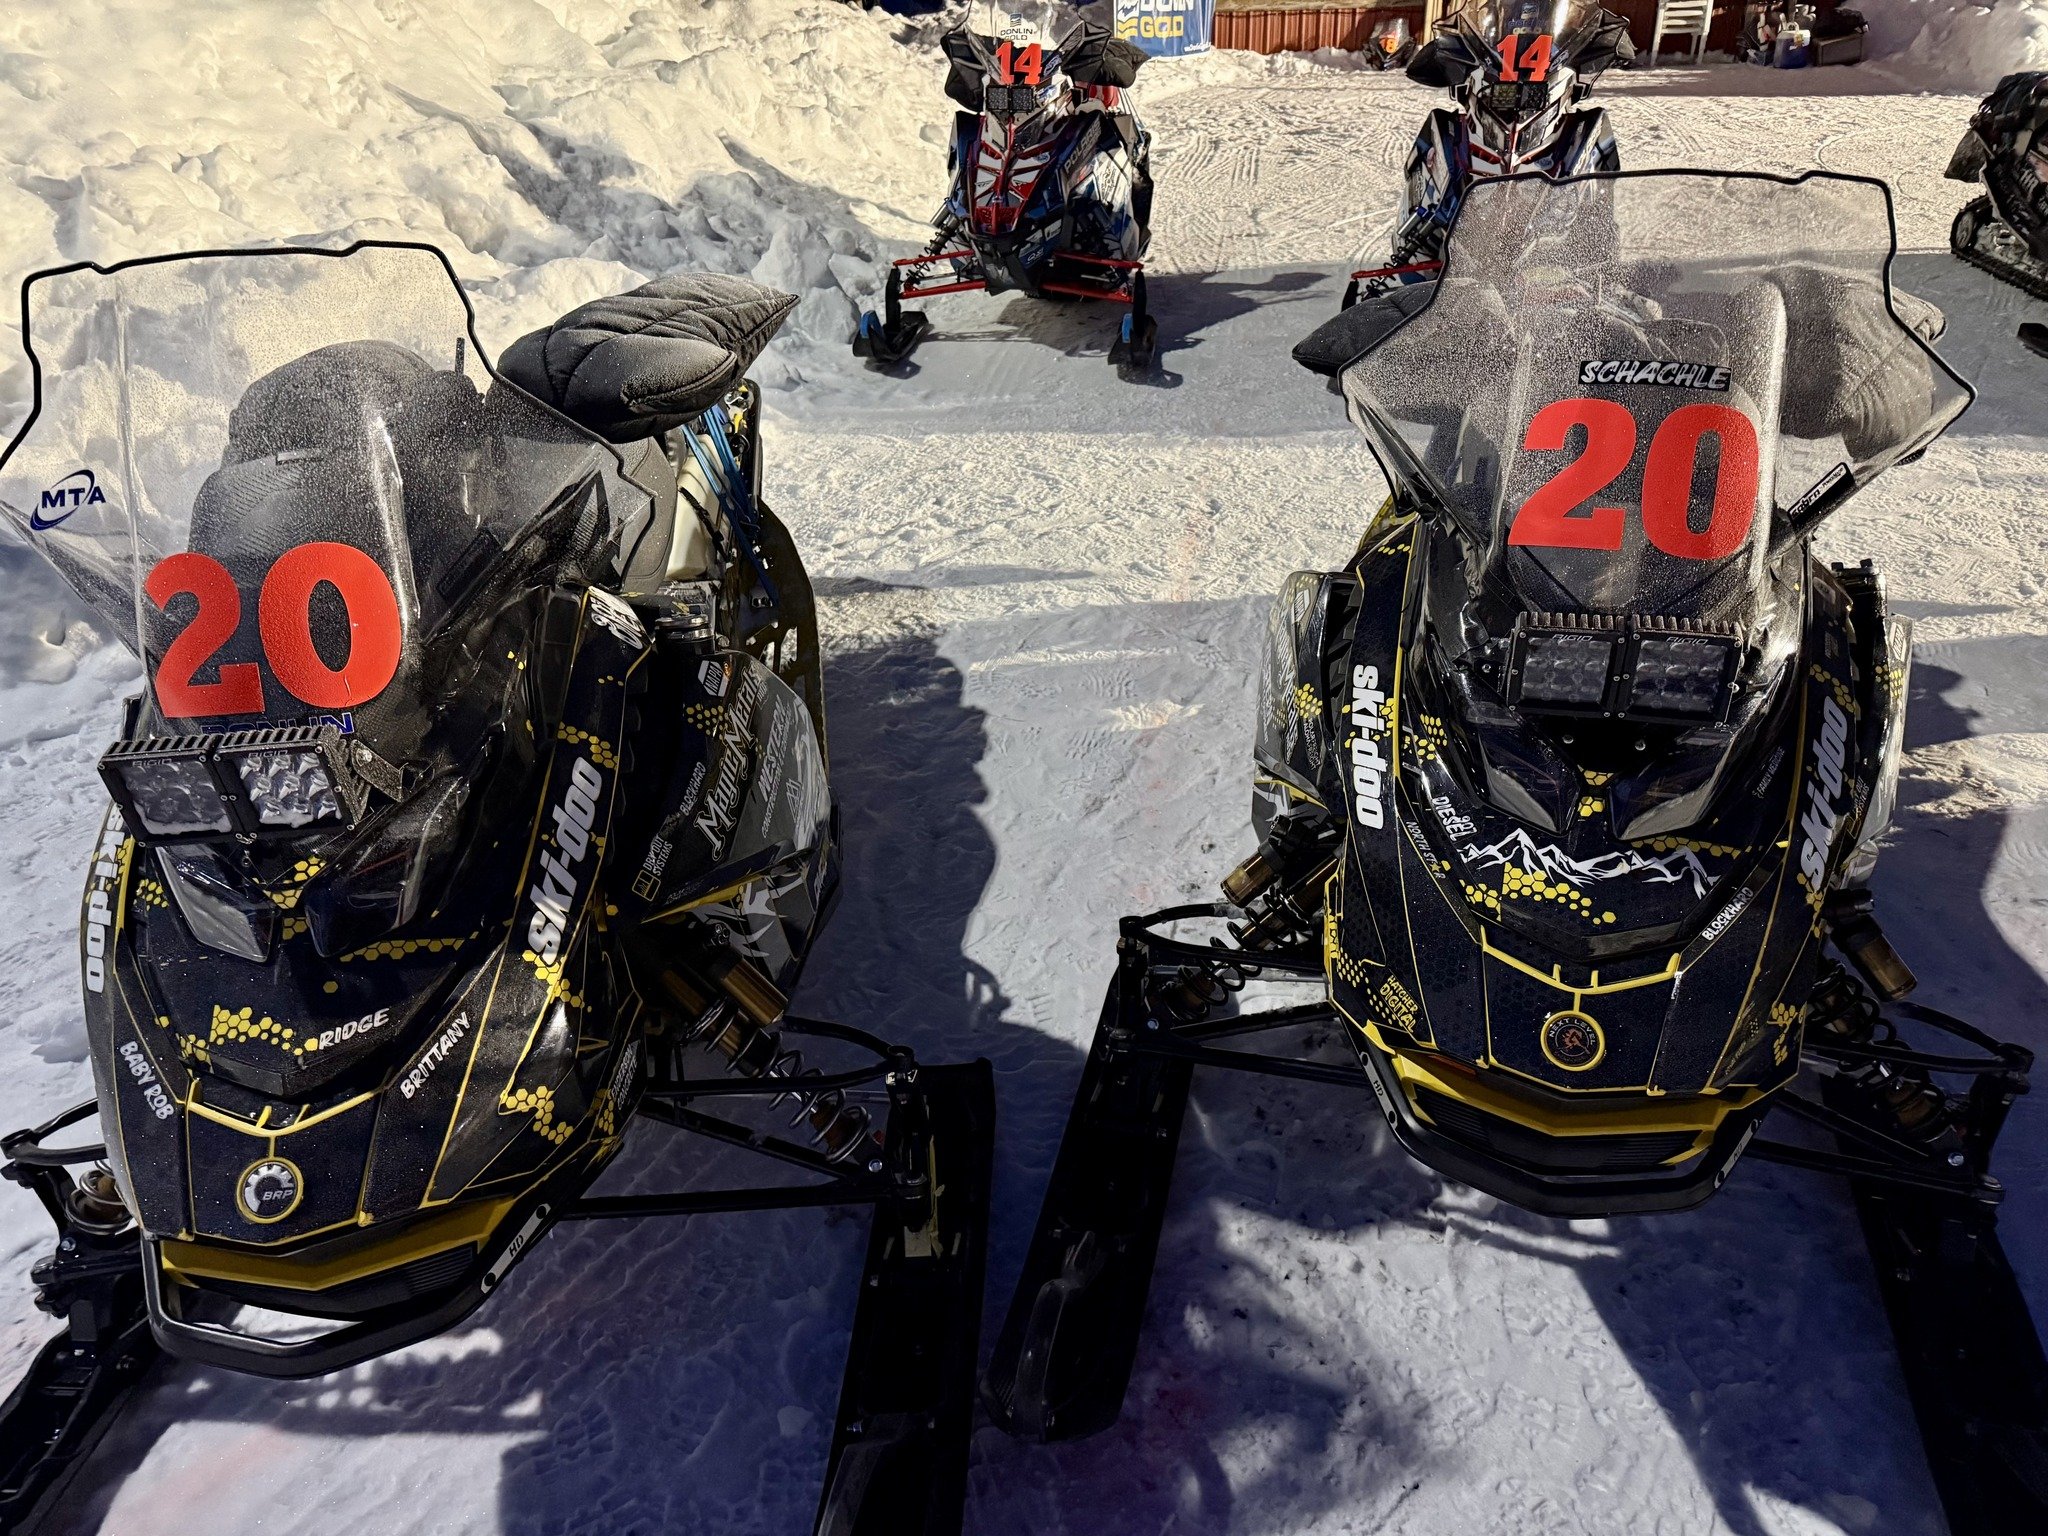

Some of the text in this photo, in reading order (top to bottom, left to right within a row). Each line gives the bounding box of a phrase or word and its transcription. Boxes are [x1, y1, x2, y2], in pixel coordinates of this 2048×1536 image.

[995, 41, 1043, 85] 14
[1496, 35, 1553, 82] 14
[1580, 360, 1729, 389] SCHACHLE
[42, 486, 106, 509] MTA
[1508, 397, 1760, 560] 20
[144, 541, 402, 718] 20
[1551, 633, 1594, 642] RIGID
[1352, 664, 1387, 830] ski-doo
[680, 762, 706, 817] BLOCKHARD
[1801, 695, 1848, 892] ski-doo
[1432, 796, 1465, 841] DIESEL
[528, 756, 603, 966] ski-doo
[642, 834, 665, 871] DRY OUT
[652, 841, 673, 876] SYSTEMS
[1406, 821, 1446, 879] NORTH STR
[86, 802, 125, 993] ski-doo
[1701, 886, 1754, 941] BLOCKHARD
[1380, 983, 1416, 1033] DIGITAL
[1387, 974, 1418, 1014] HATCHER
[318, 1008, 390, 1050] RIDGE
[1549, 1018, 1597, 1045] NEXT LEVEL
[400, 1011, 472, 1100] BRITTANY
[120, 1041, 174, 1120] BABY ROB
[1373, 1080, 1384, 1097] HD
[263, 1188, 296, 1202] BRP
[509, 1234, 524, 1258] HD
